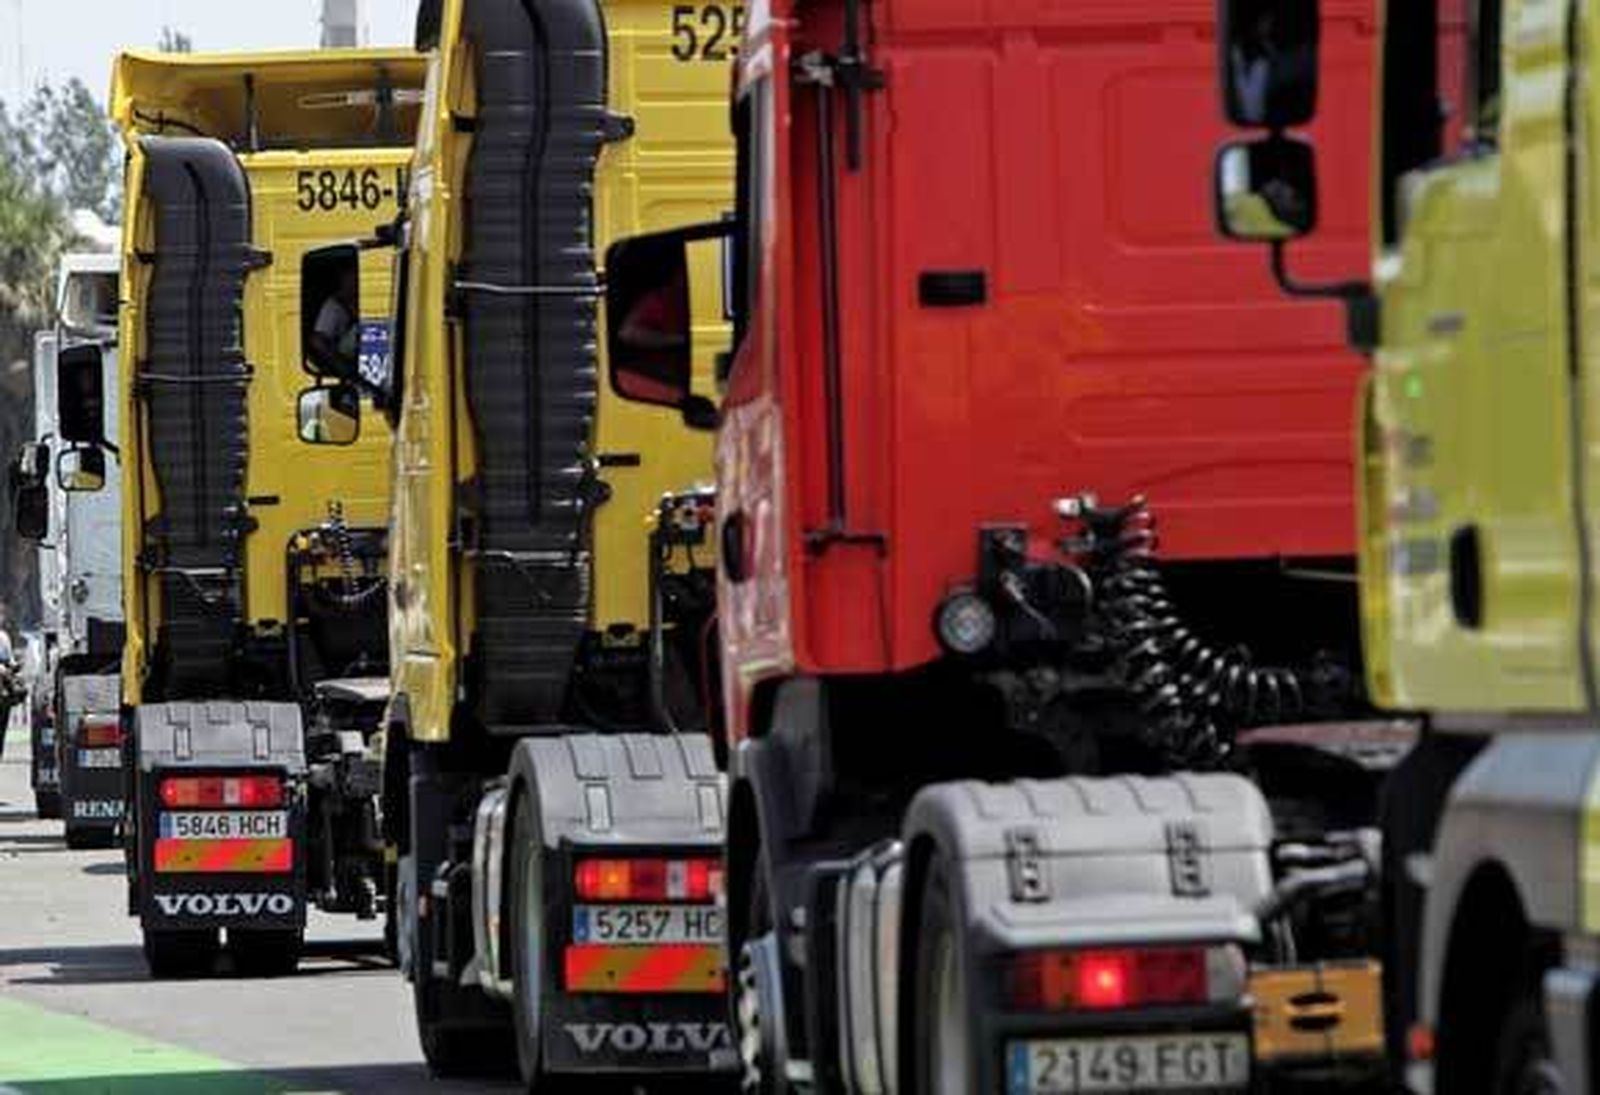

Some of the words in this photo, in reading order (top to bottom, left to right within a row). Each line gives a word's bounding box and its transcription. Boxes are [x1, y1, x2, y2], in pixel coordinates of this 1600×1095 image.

[176, 815, 230, 836] 5846
[239, 815, 280, 835] HCH
[154, 893, 294, 915] VOLVO
[597, 909, 671, 938] 5257
[1035, 1046, 1139, 1089] 2149
[1156, 1040, 1235, 1083] FGT
